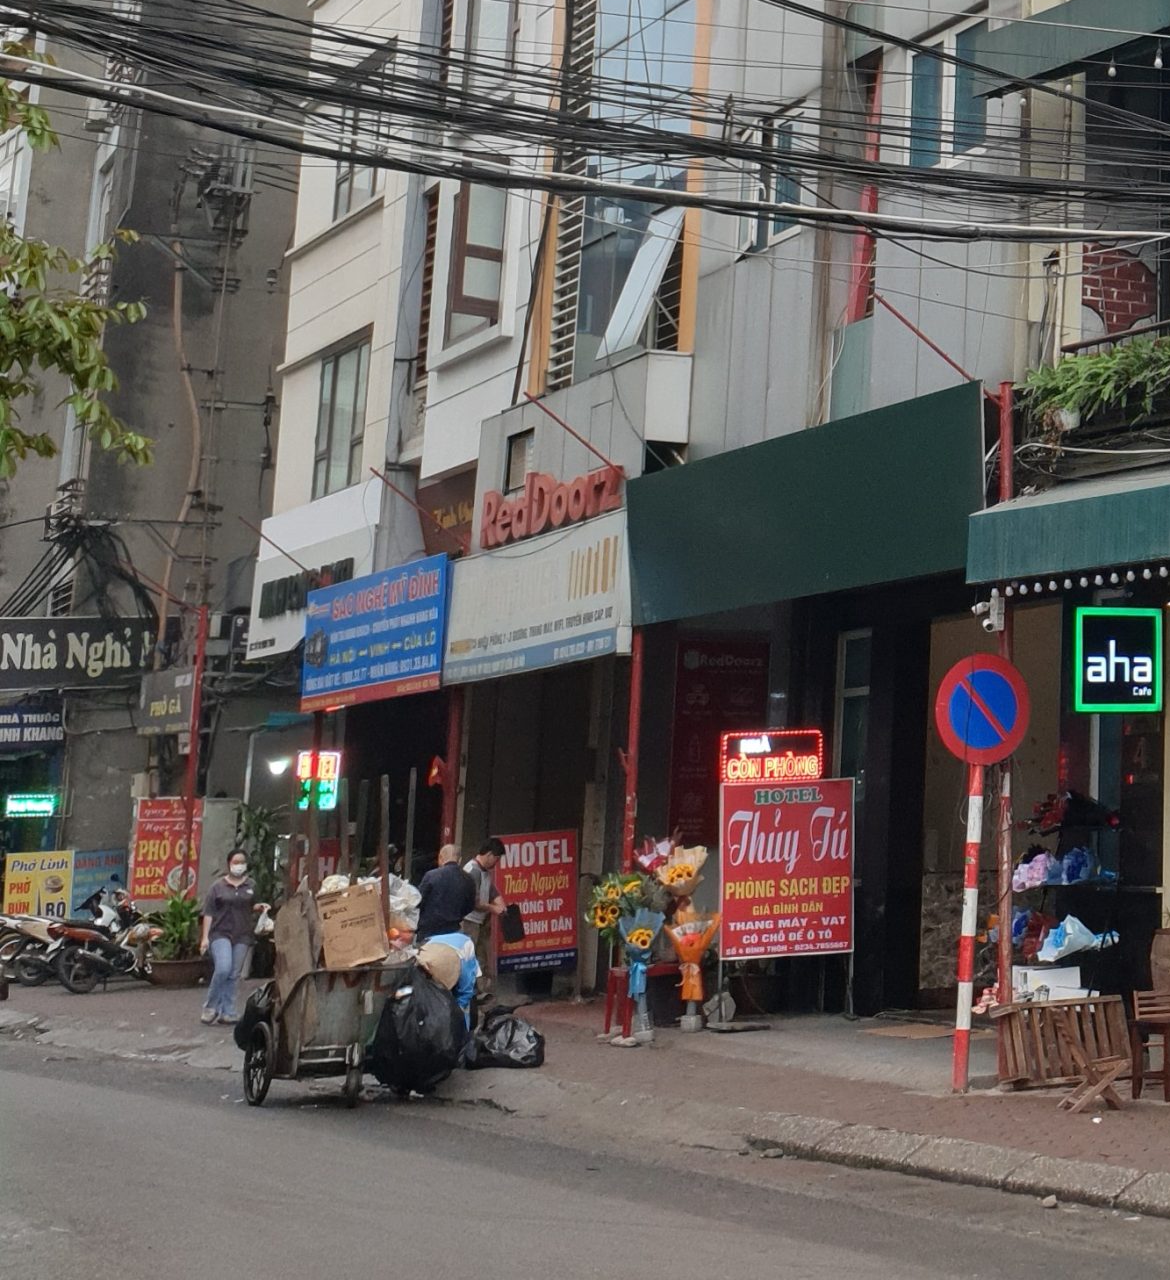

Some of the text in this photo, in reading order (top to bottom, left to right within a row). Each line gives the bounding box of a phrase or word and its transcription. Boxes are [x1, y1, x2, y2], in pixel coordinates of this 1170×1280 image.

[480, 465, 624, 549] RedDoorz
[1, 629, 57, 670] Nhà
[65, 627, 132, 678] Nghỉ
[1087, 640, 1153, 683] aha
[1133, 686, 1152, 696] Cafe
[23, 726, 64, 742] KHANG
[727, 751, 819, 779] CÒN PHÒNG
[754, 786, 823, 805] HOTEL
[137, 831, 170, 861] PHỞ
[728, 806, 849, 874] Thủy Tú
[500, 838, 573, 869] MOTEL
[11, 856, 69, 872] Phở Linh
[136, 864, 164, 879] BÚN
[9, 876, 32, 895] PHỞ
[134, 880, 168, 896] MIẾN
[505, 870, 569, 896] Thảo Nguyên
[725, 876, 850, 900] PHÒNG SẠCH ĐẸP
[8, 900, 30, 915] BÚN
[547, 898, 564, 912] VIP
[752, 901, 824, 916] GIÁ BÌNH DÂN
[729, 915, 847, 931] THANG MÁY VAT
[742, 933, 758, 944] CÓ
[762, 930, 786, 943] CHỖ
[807, 929, 815, 940] Ô
[818, 929, 832, 939] TÔ
